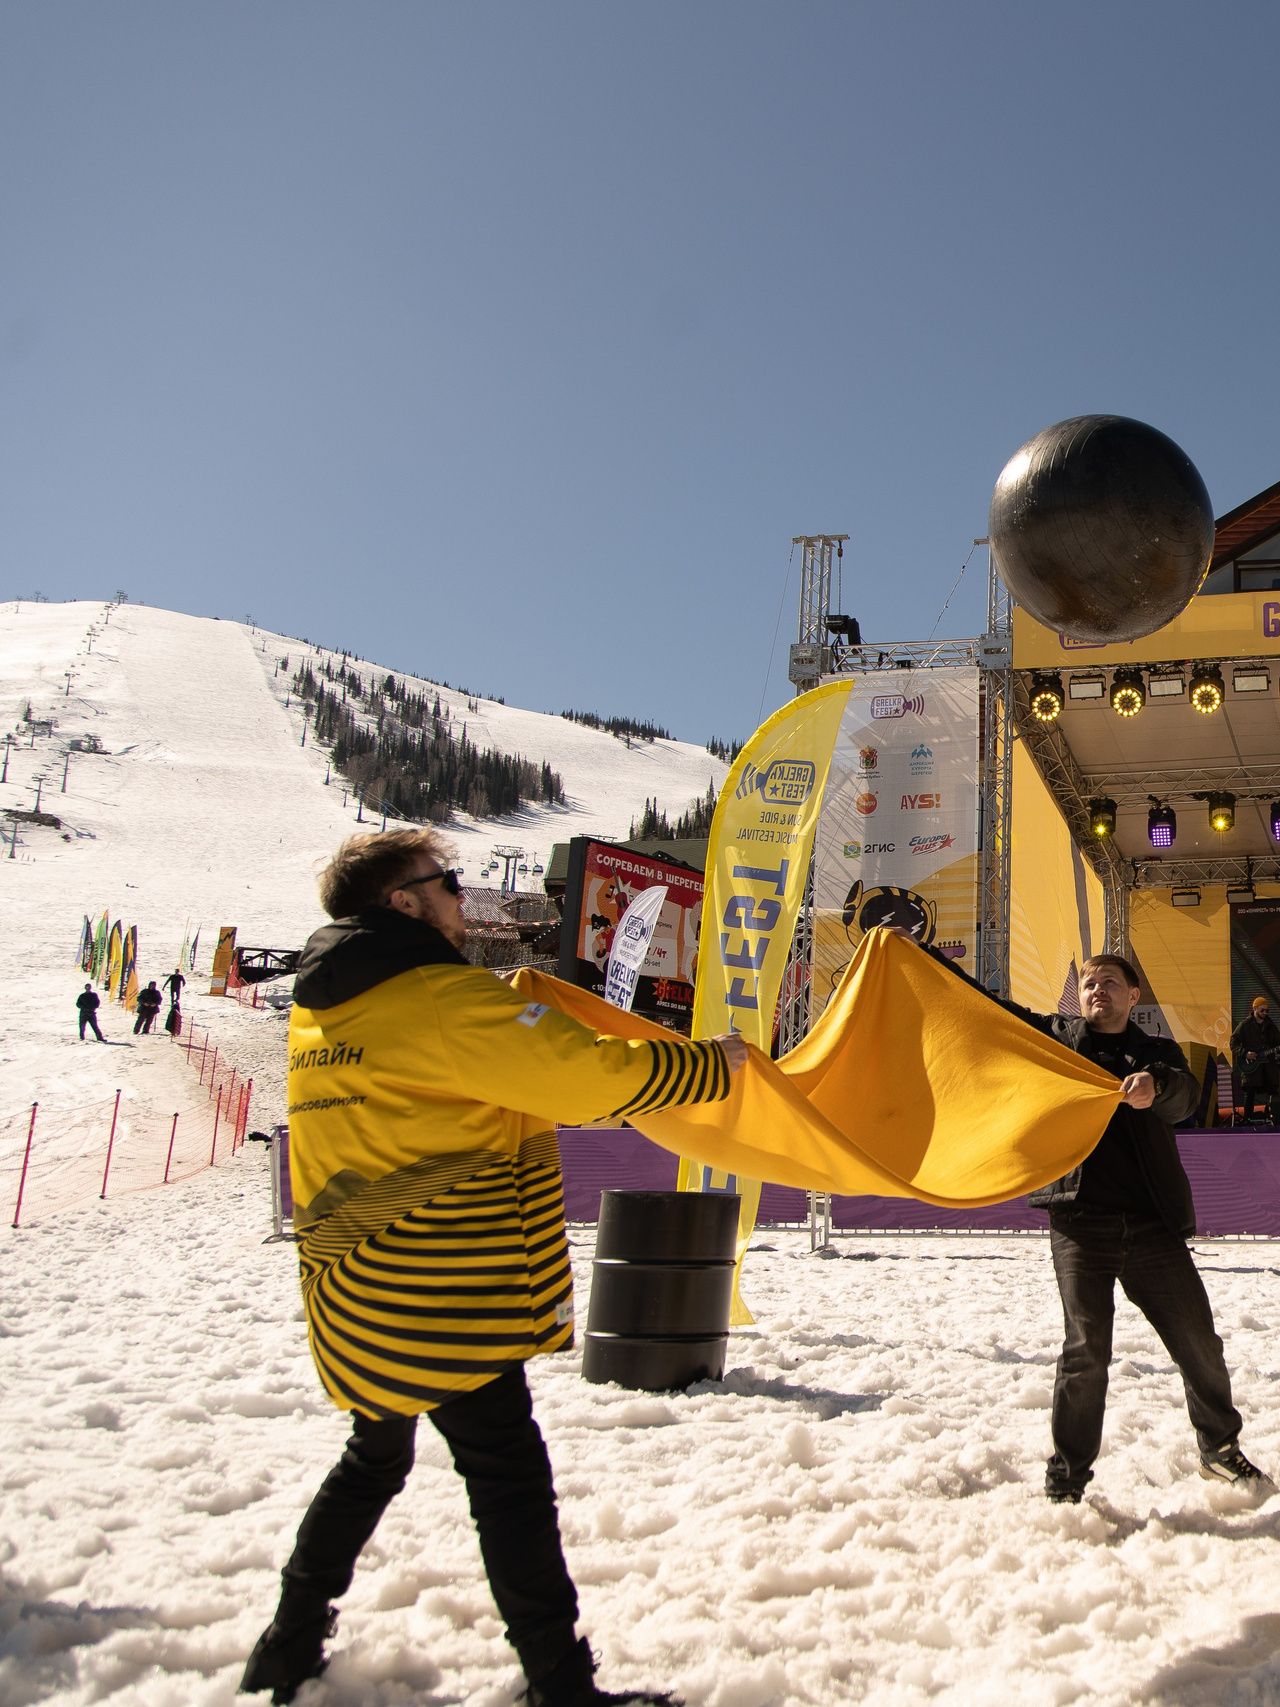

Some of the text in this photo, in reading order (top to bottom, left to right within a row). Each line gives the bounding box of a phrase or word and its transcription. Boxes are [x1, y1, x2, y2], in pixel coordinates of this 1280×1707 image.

[875, 697, 902, 707] GRELKA
[875, 706, 893, 716] FEST
[900, 793, 941, 810] AYS!
[864, 843, 896, 854] 2ГИС
[596, 853, 654, 879] СОГРЕВАЕМ
[656, 870, 663, 880] В
[657, 981, 695, 1004] GRELK
